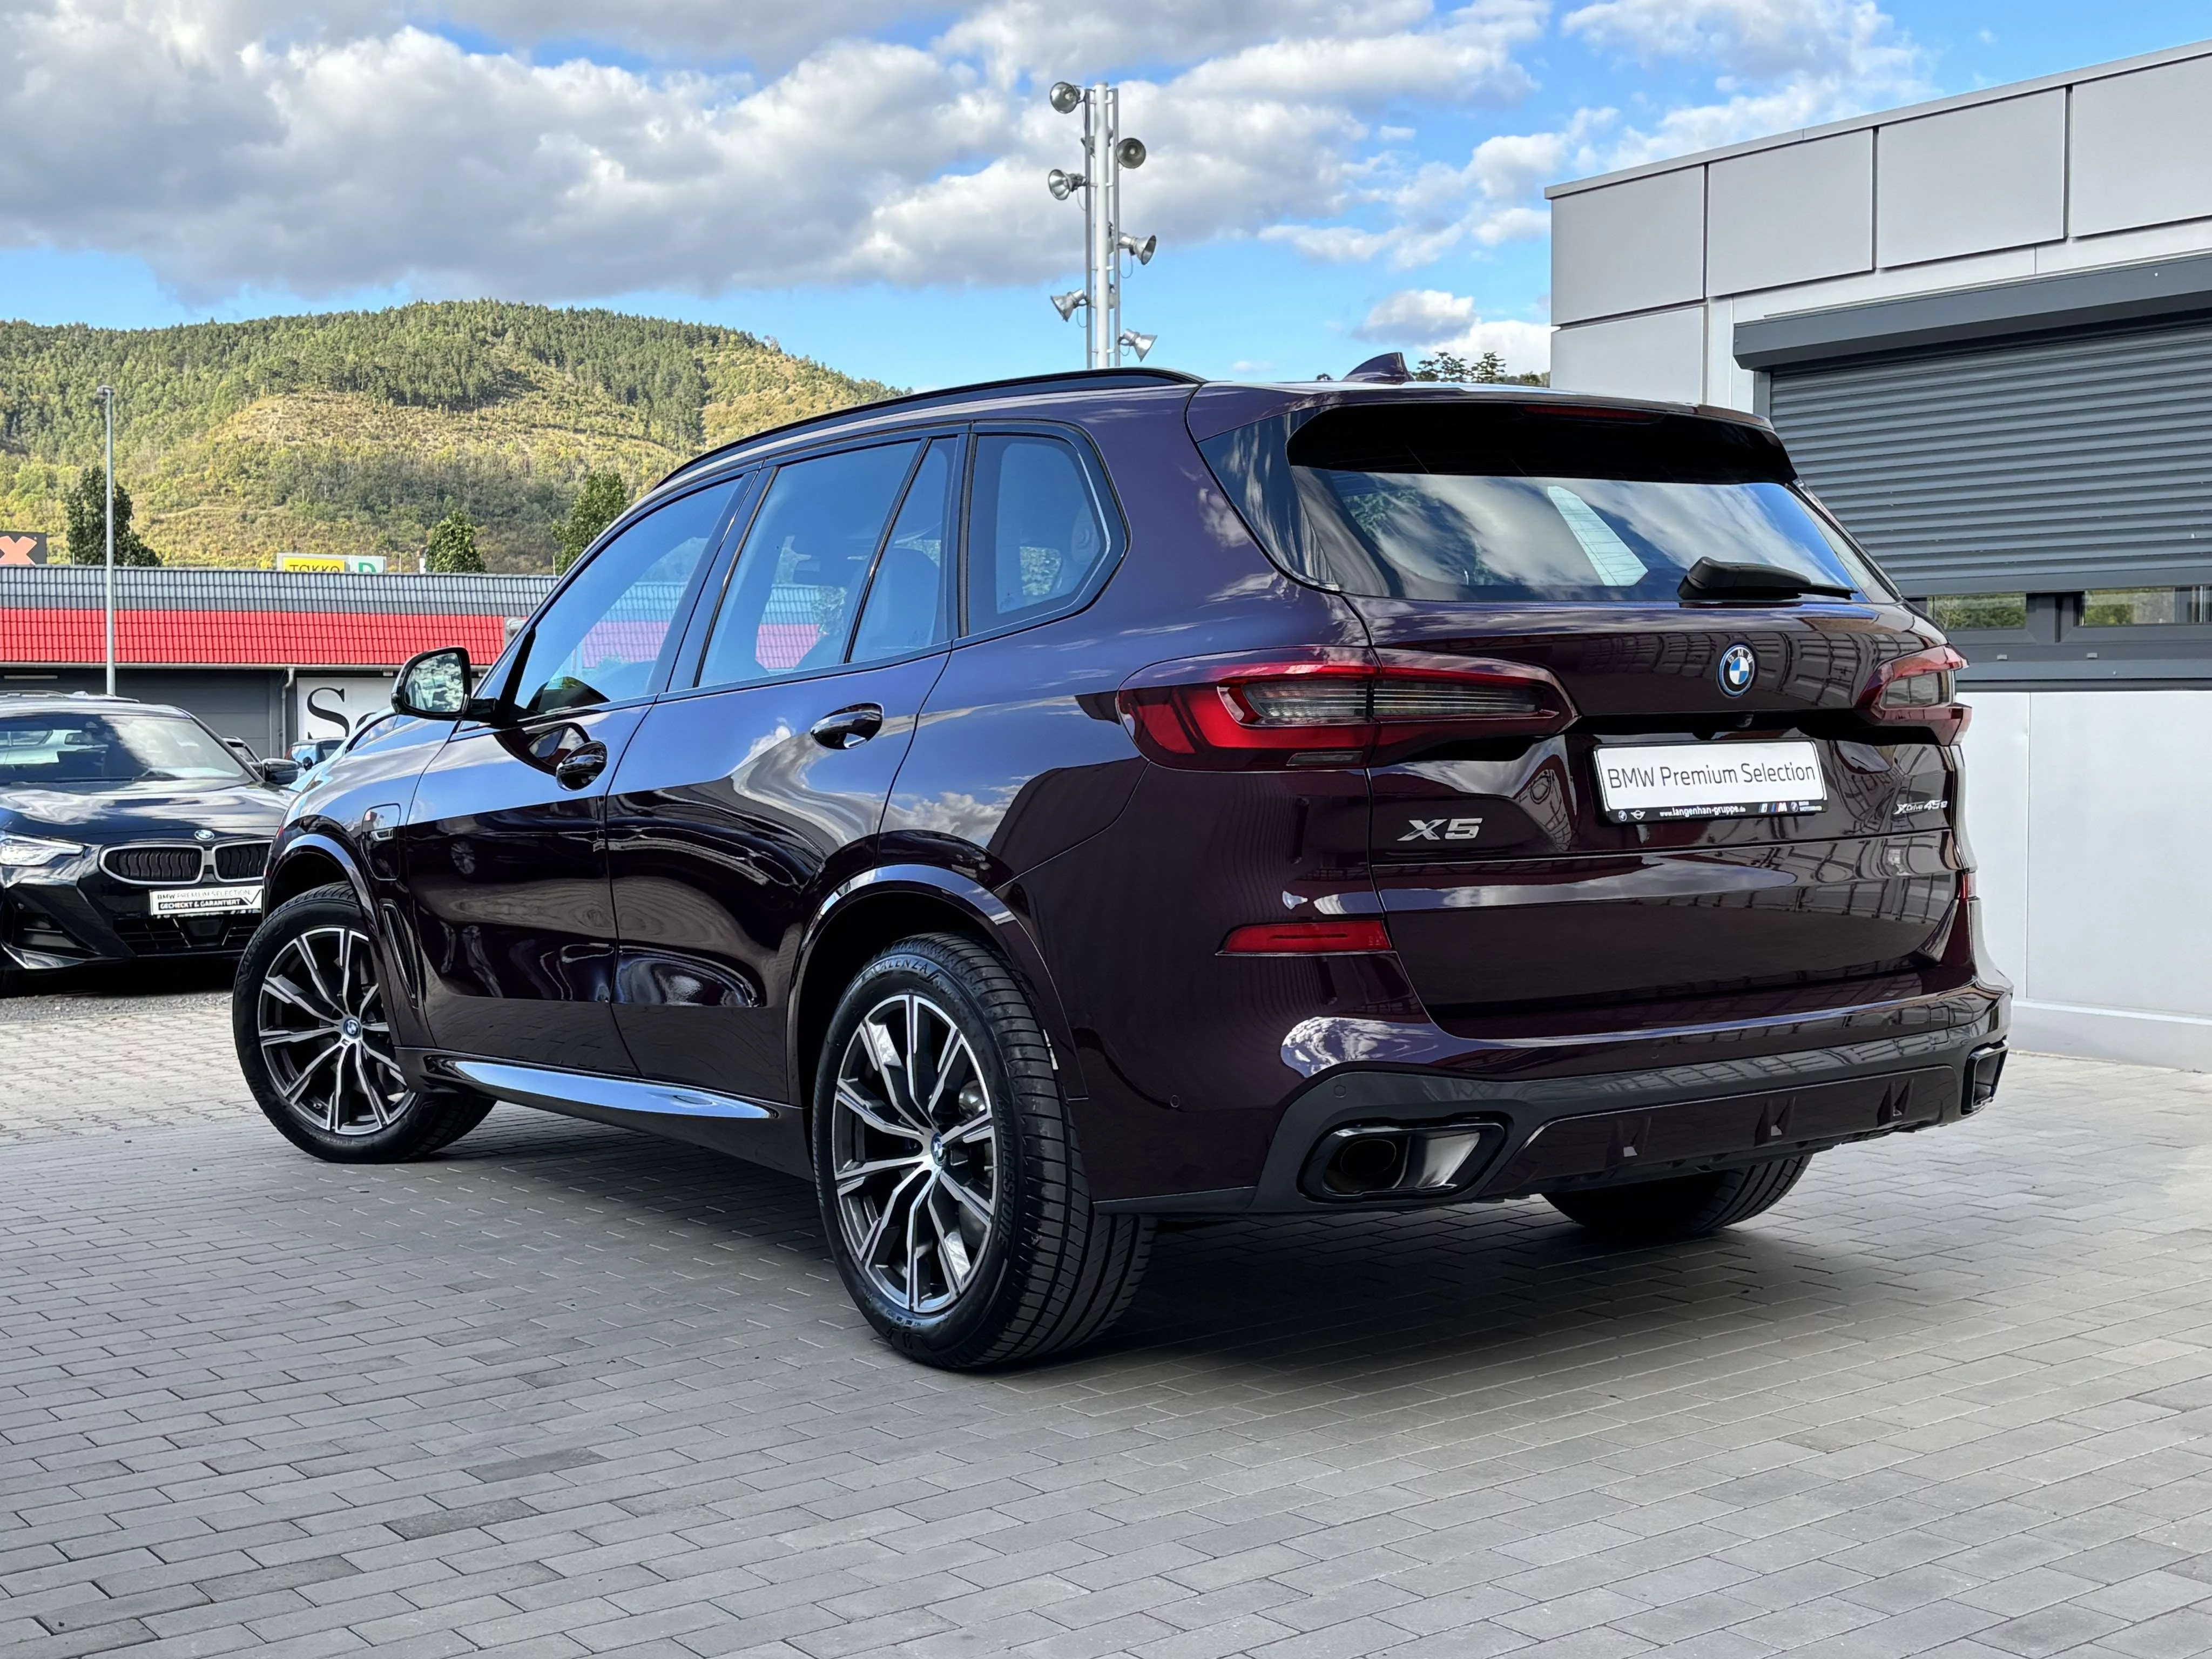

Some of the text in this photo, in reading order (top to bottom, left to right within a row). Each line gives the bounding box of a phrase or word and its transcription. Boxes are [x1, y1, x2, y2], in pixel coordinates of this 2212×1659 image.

[1607, 761, 1816, 788] BMW Premium Selection
[1659, 805, 1746, 818] www.langenhan-gruppe.de
[1397, 818, 1483, 841] X5
[200, 899, 240, 907] GARANTIERT
